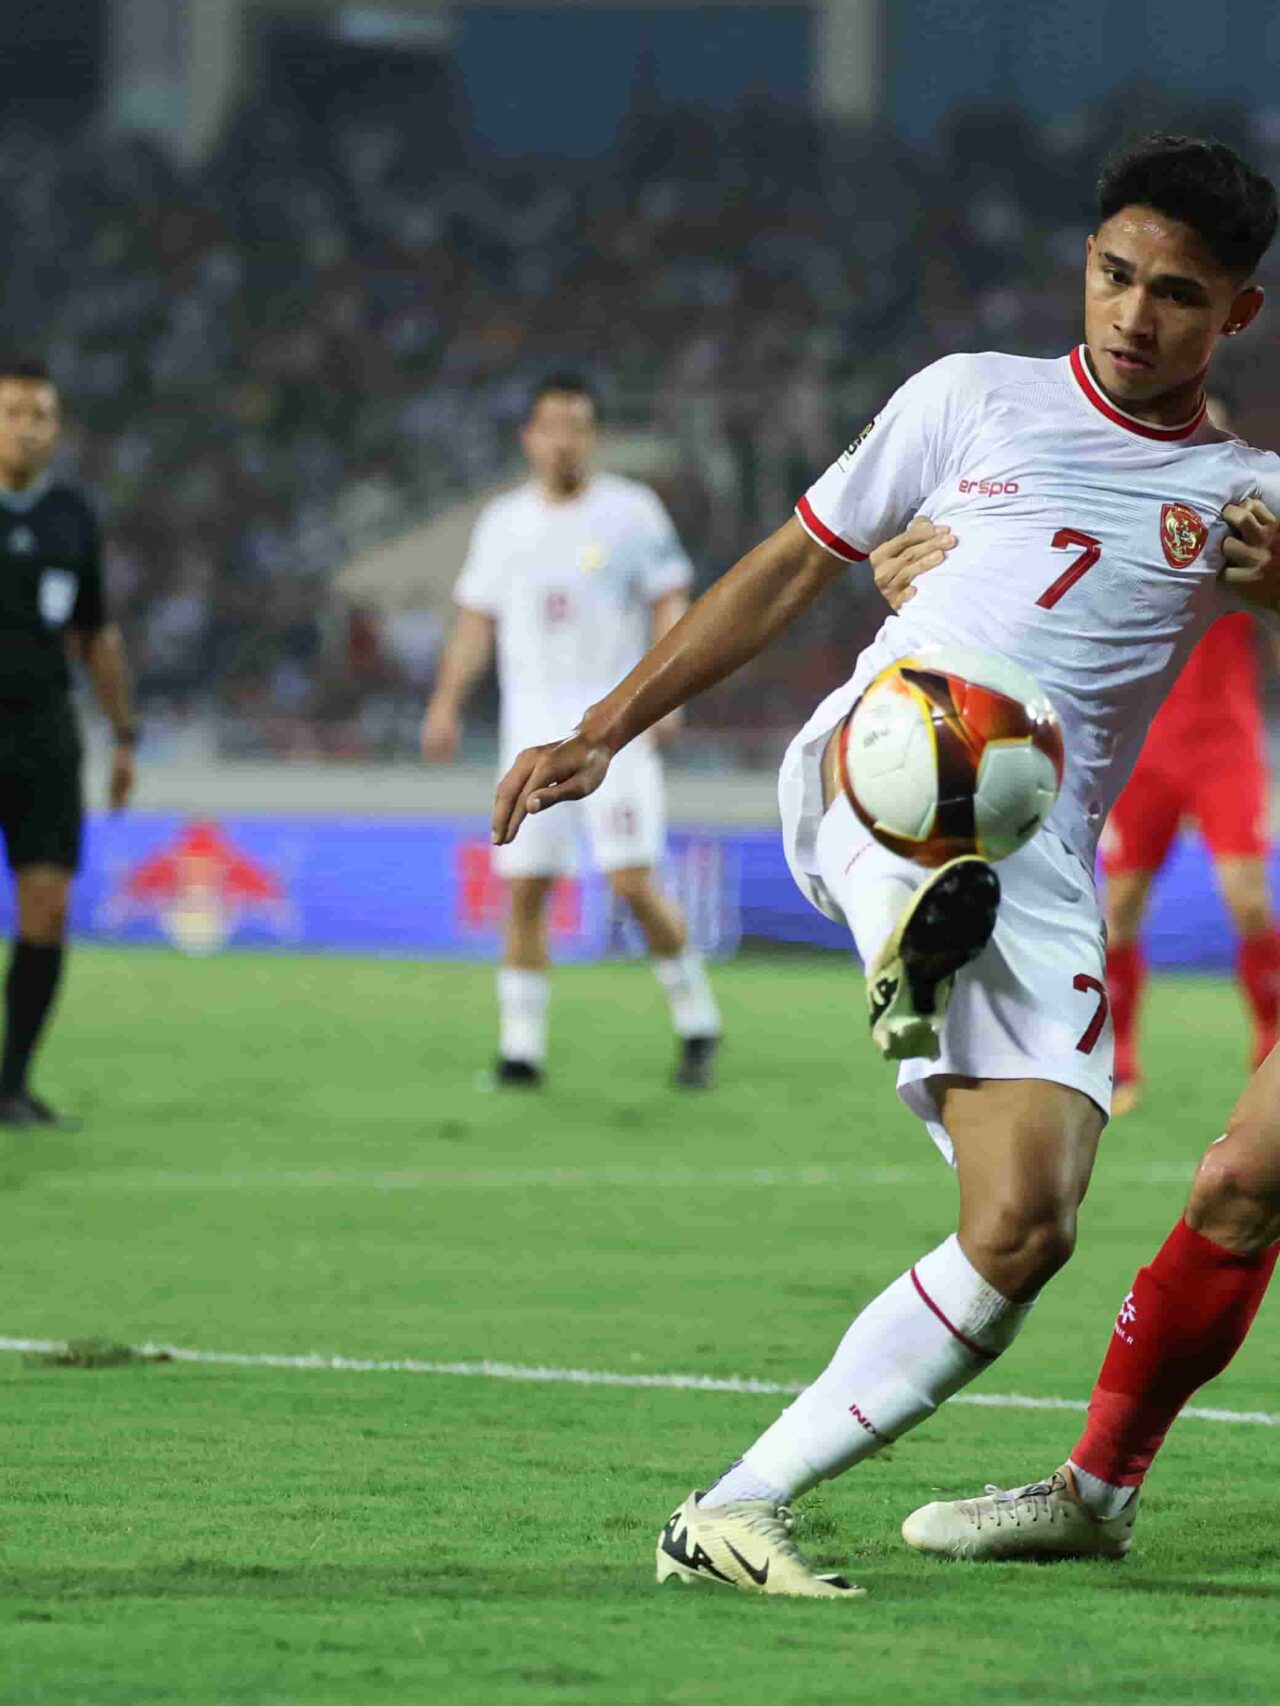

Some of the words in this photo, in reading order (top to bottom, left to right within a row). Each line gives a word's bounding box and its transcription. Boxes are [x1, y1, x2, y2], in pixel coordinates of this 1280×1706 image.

[958, 479, 1019, 497] erspo
[1034, 527, 1103, 609] 7
[1072, 973, 1108, 1056] 7
